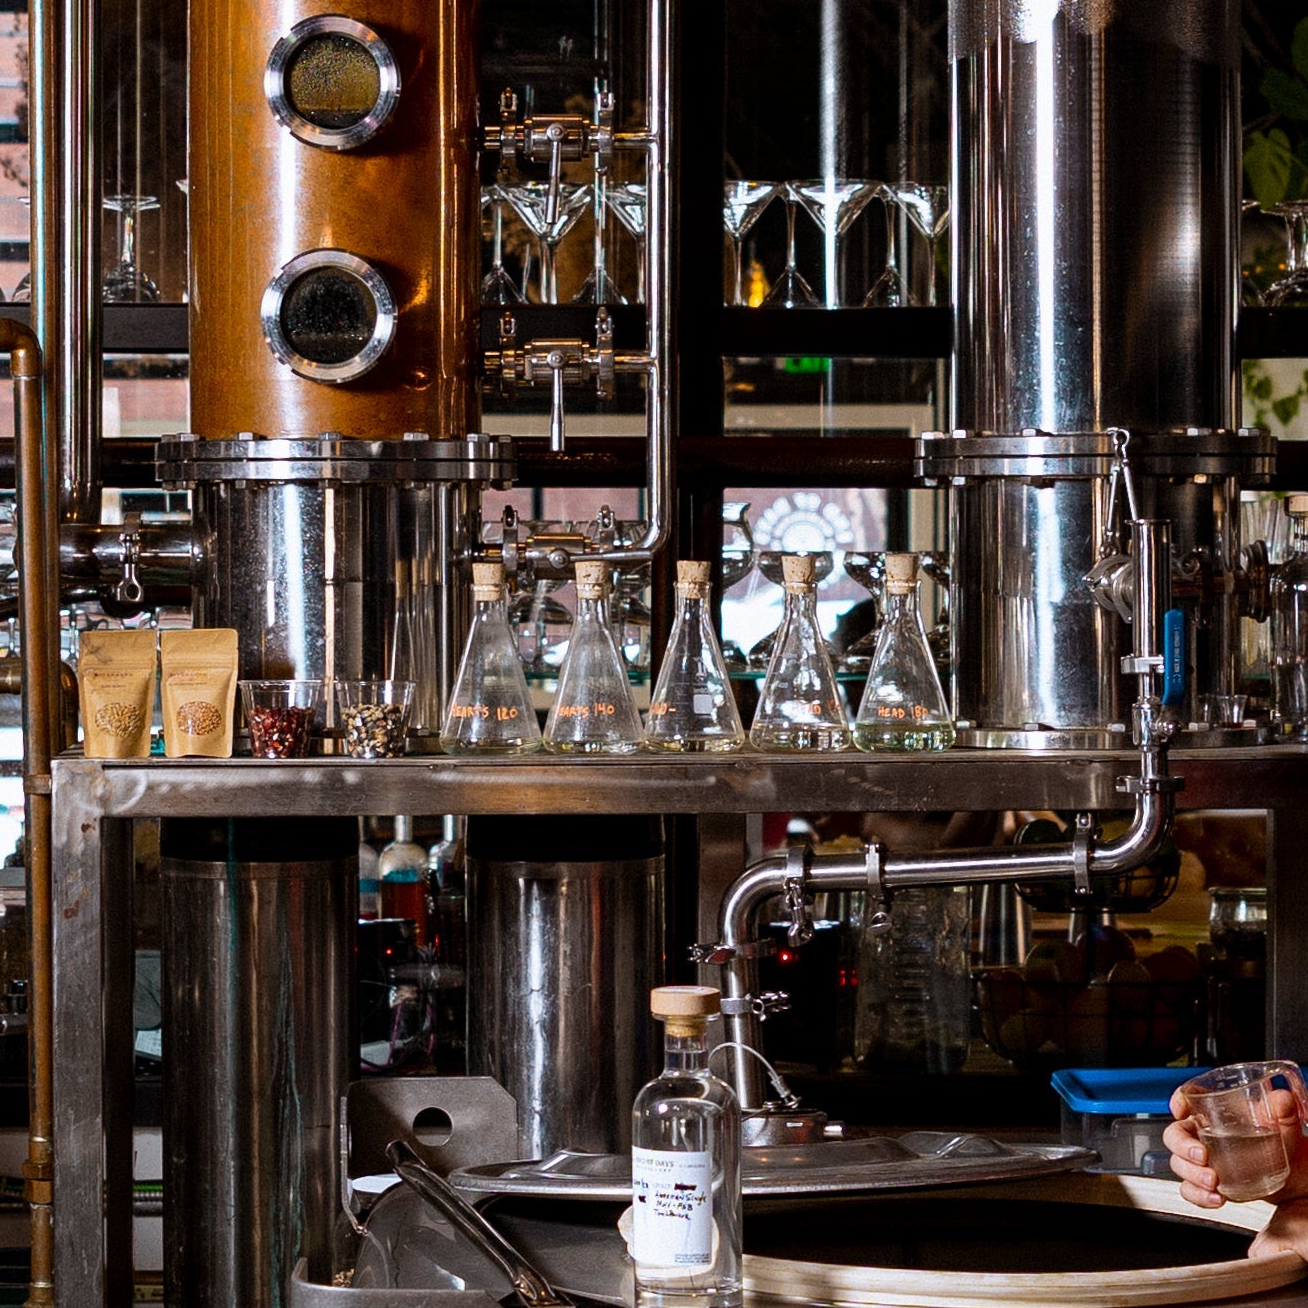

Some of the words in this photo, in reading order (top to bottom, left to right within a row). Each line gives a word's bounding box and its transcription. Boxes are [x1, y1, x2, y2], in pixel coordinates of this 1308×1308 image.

[496, 706, 518, 722] 120
[594, 702, 615, 717] 140
[878, 706, 905, 719] HEAD
